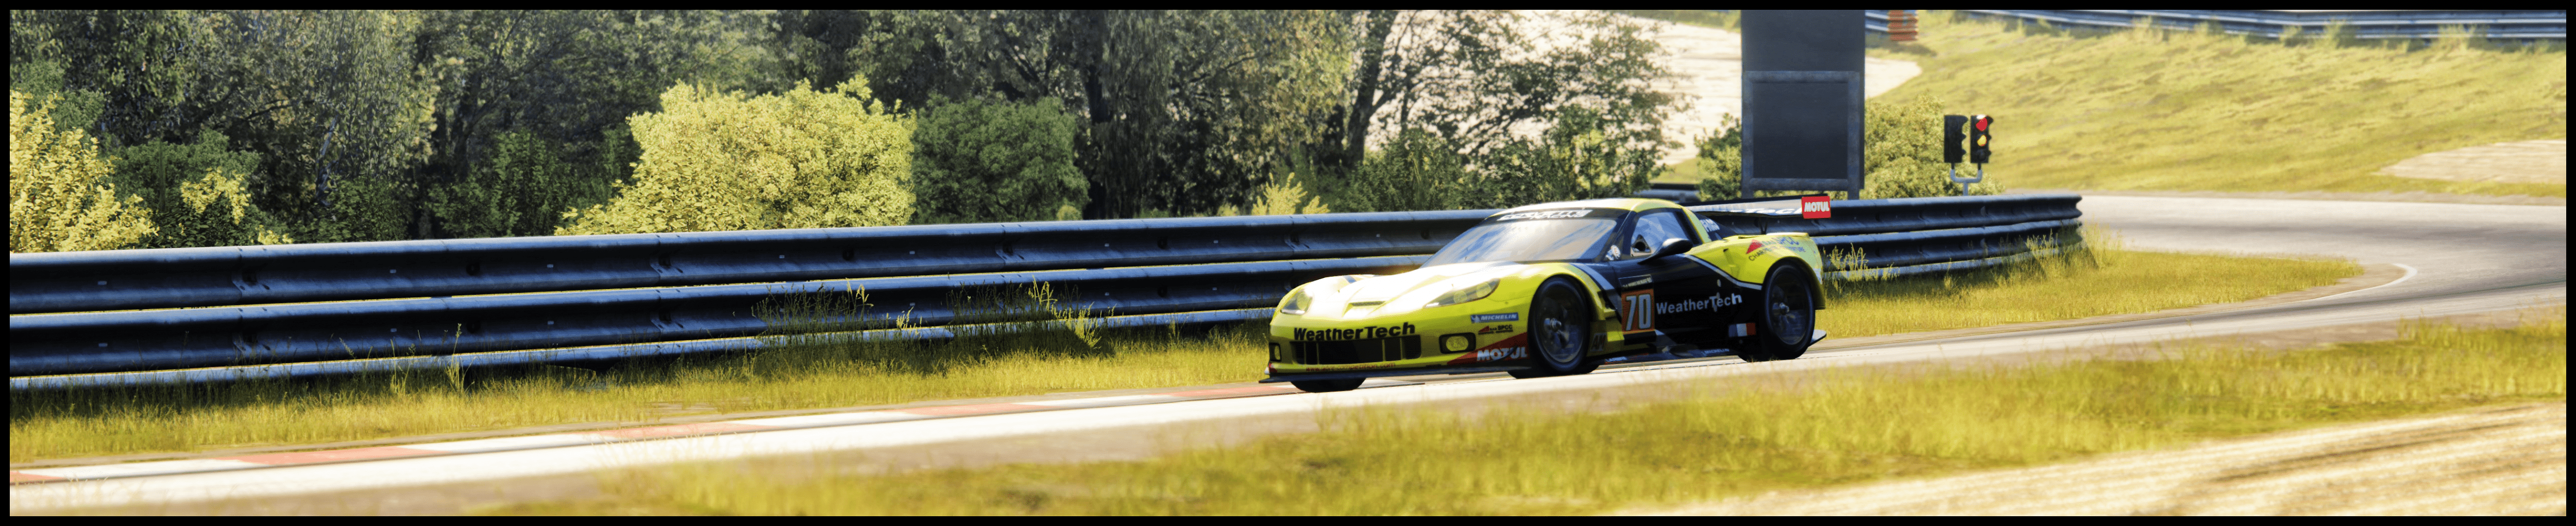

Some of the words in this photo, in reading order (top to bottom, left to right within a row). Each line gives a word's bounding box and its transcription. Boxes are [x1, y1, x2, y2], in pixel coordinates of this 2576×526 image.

[1804, 201, 1829, 212] MOTUL
[1626, 294, 1651, 331] 70
[1656, 293, 1742, 314] WeatherTech
[1294, 322, 1415, 341] WeatherTech
[1477, 347, 1528, 361] MOTUL
